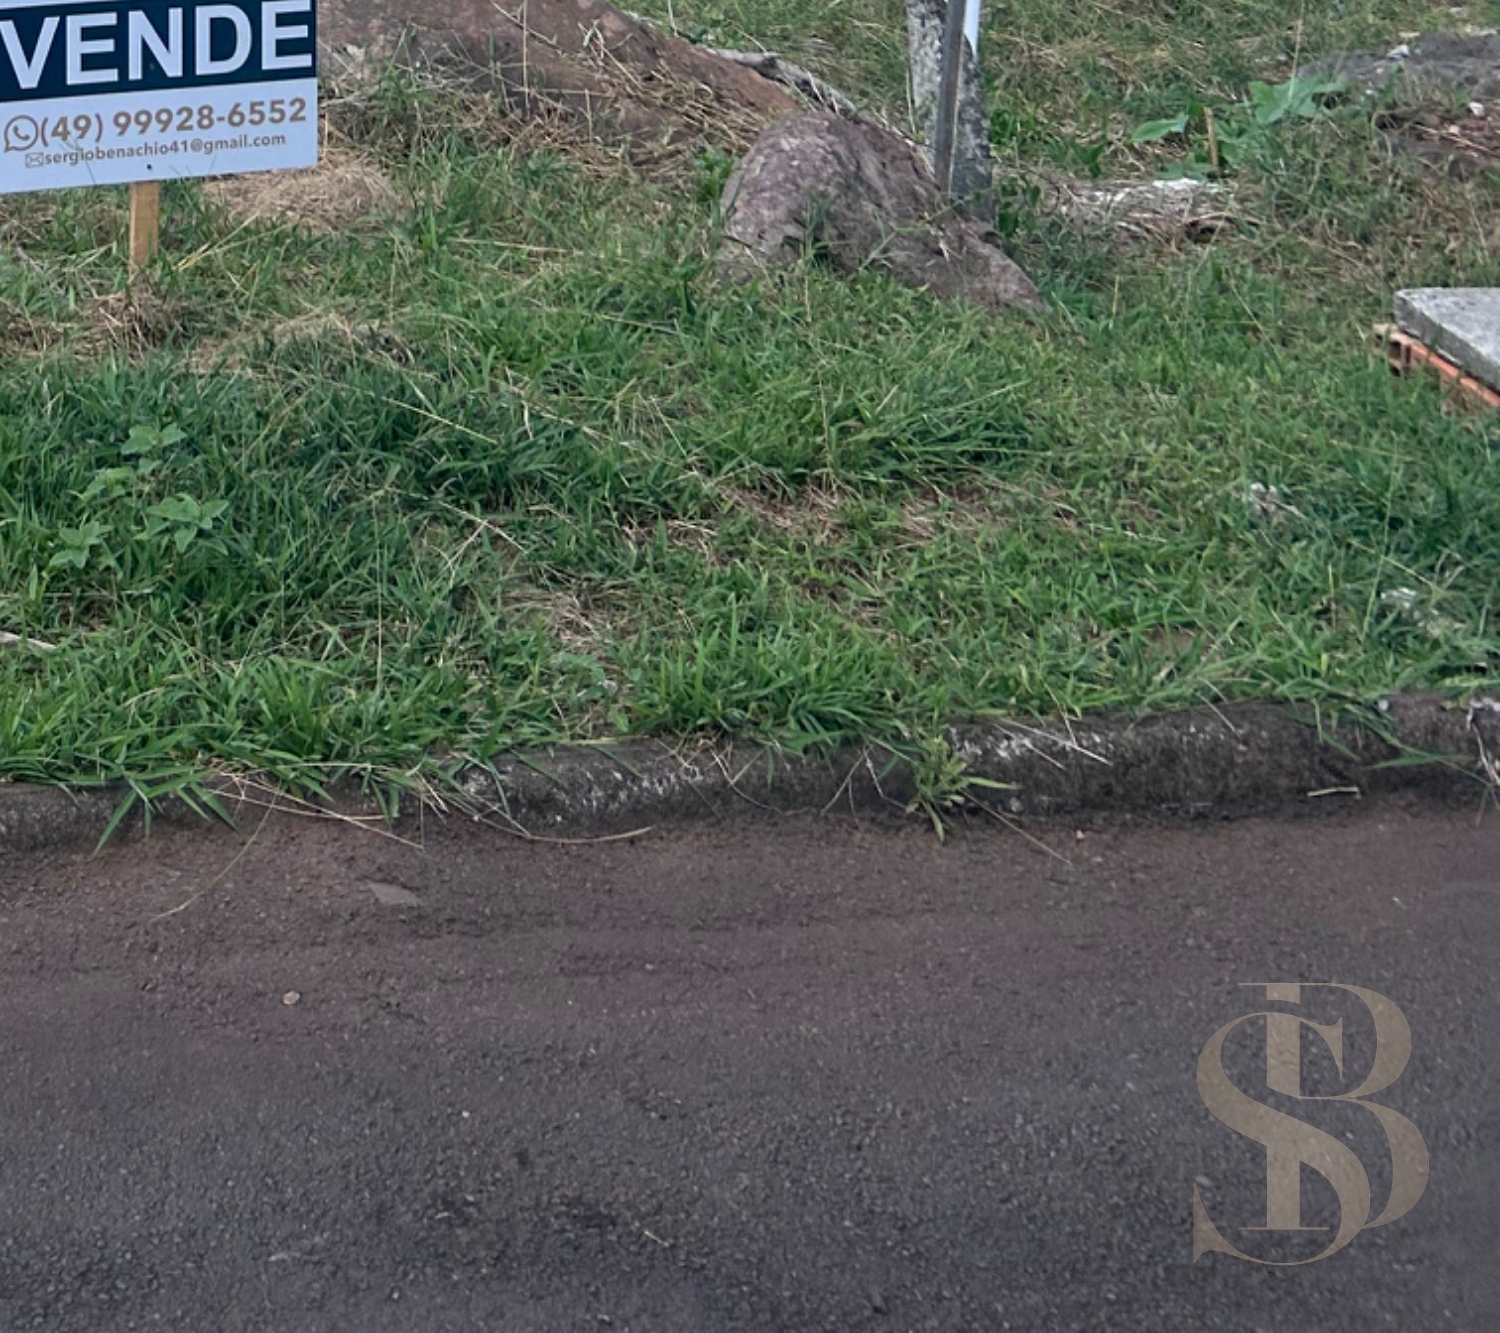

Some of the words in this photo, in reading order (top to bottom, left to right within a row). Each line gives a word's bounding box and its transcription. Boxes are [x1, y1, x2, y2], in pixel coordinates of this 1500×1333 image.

[40, 113, 104, 148] (49)
[112, 97, 307, 136] 99928-6552
[44, 133, 286, 166] sergiobenachio41@gmail.com
